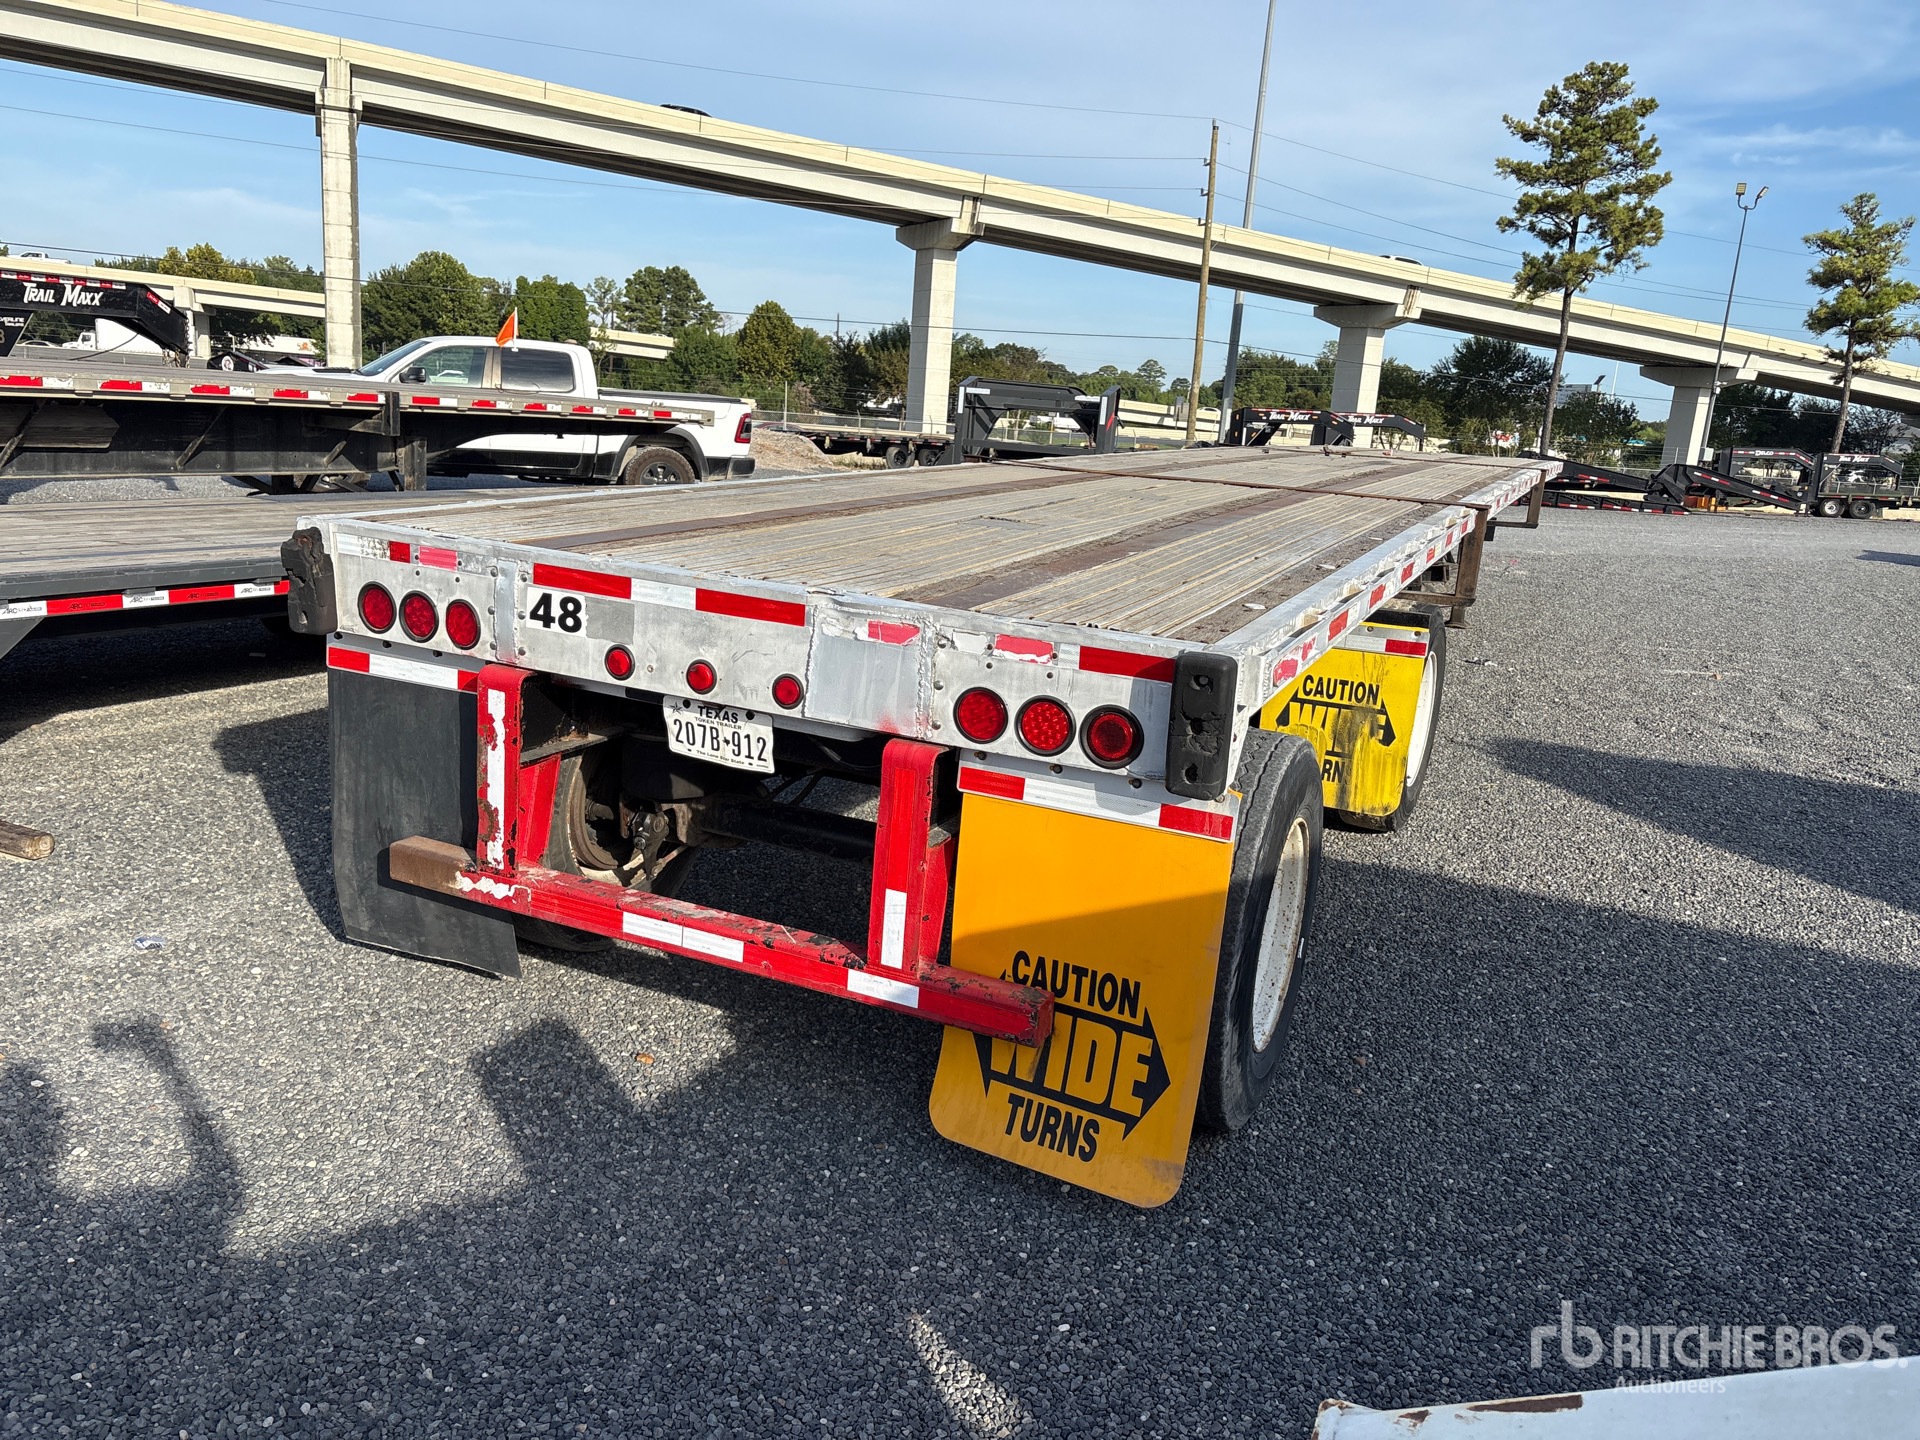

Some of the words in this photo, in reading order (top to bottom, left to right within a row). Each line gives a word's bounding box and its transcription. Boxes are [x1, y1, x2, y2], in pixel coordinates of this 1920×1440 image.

[23, 282, 55, 303] TRAIL
[60, 283, 103, 307] MAXX
[529, 593, 582, 633] 48
[1302, 674, 1380, 706] CAUTION
[694, 716, 715, 725] TOKEN
[716, 720, 742, 730] TRAILER
[698, 705, 739, 724] TEXAS
[1011, 950, 1141, 1019] CAUTION
[1004, 1093, 1100, 1163] TURNS
